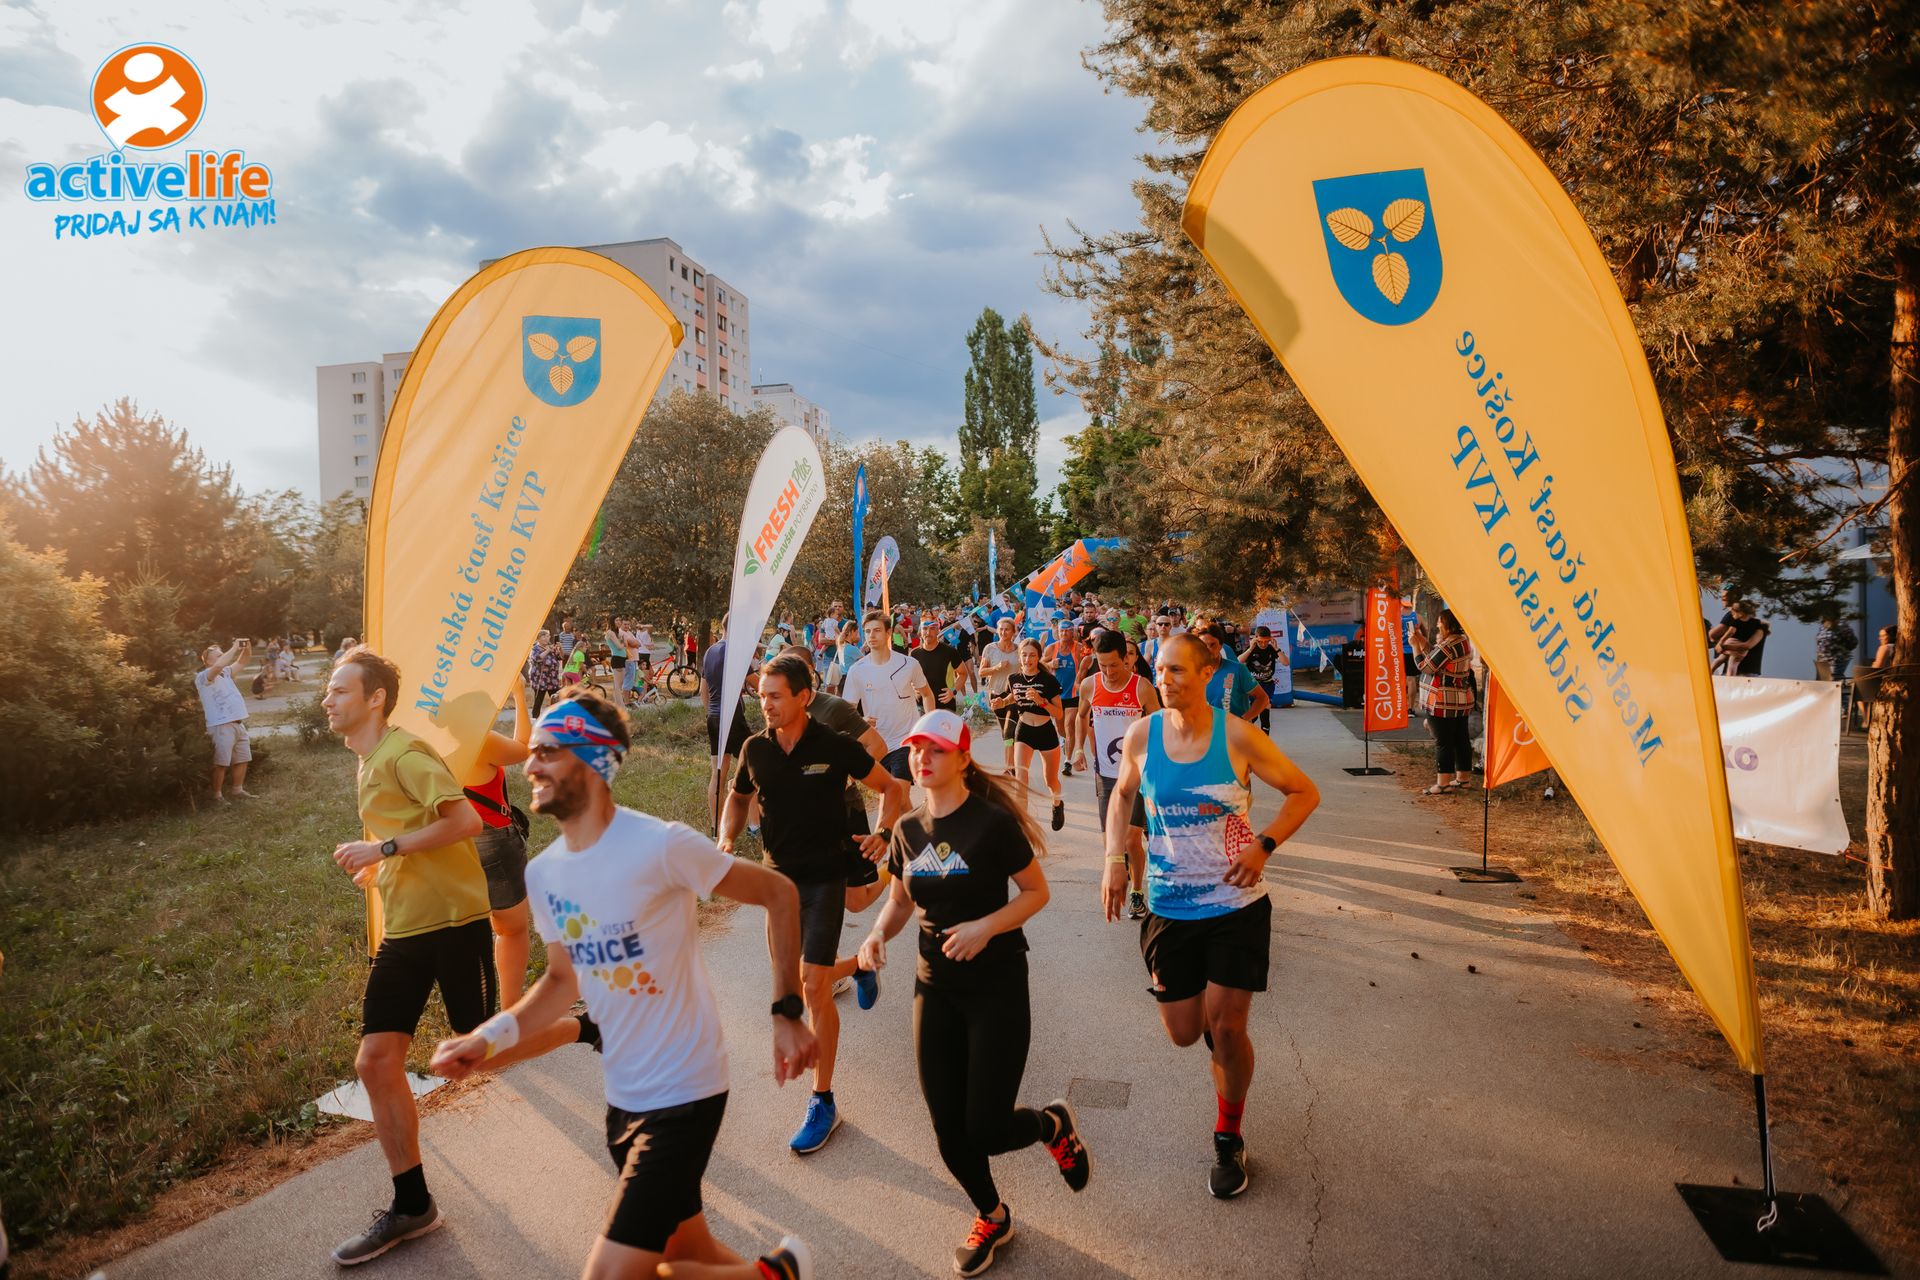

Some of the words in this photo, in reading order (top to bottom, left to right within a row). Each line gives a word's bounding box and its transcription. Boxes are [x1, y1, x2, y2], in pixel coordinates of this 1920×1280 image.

[753, 479, 800, 563] FRESH
[415, 590, 474, 717] Mestská
[456, 511, 495, 584] časť
[477, 414, 528, 512] Košice
[470, 546, 527, 673] Sídlisko
[510, 470, 547, 542] KVP
[872, 555, 889, 585] FREH
[1387, 621, 1398, 657] Company
[1157, 802, 1222, 817] activelife
[600, 920, 635, 936] VISIT
